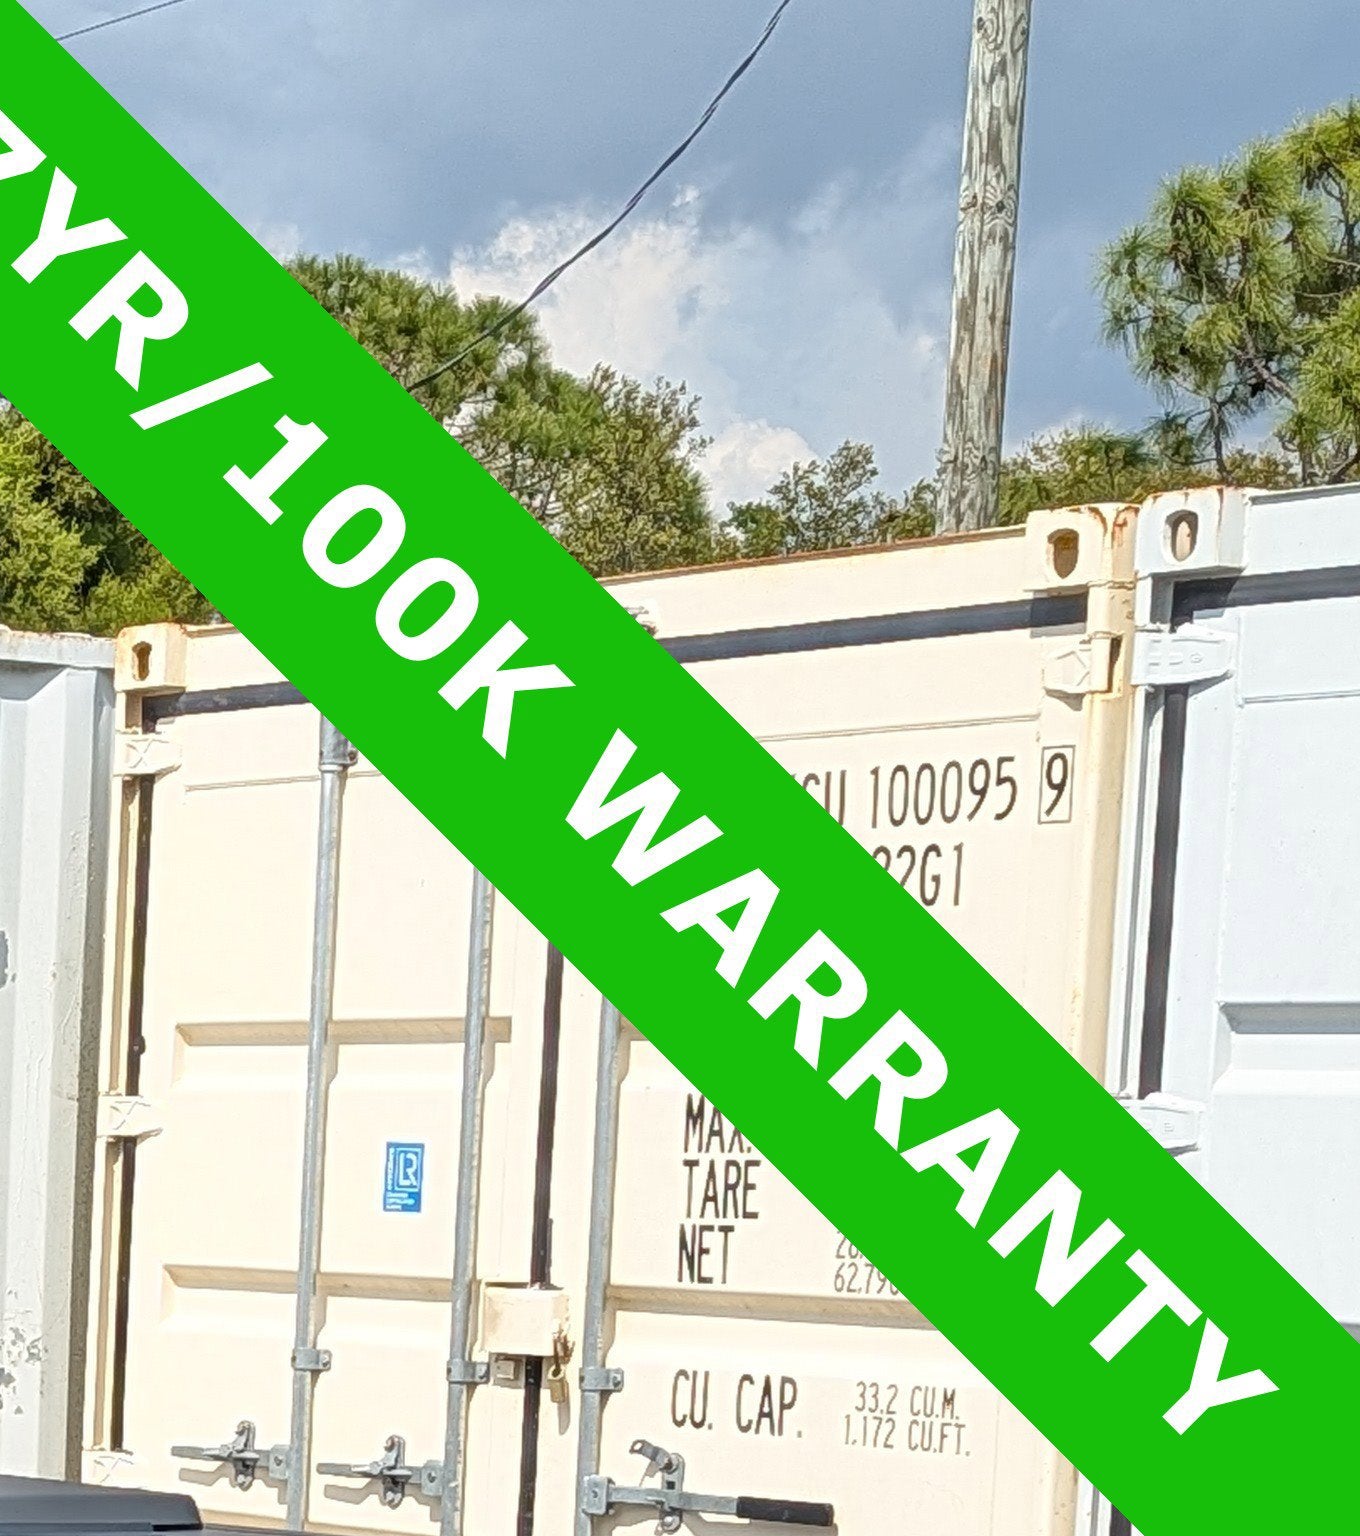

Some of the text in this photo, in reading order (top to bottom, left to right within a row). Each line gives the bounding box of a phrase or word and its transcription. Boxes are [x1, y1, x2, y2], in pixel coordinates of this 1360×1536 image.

[870, 756, 1018, 829] 100095
[1043, 751, 1070, 818] 9
[683, 1158, 762, 1220] TARE
[678, 1222, 735, 1285] NET
[671, 1368, 802, 1438] CU. CAP.
[855, 1381, 899, 1415] 33.2
